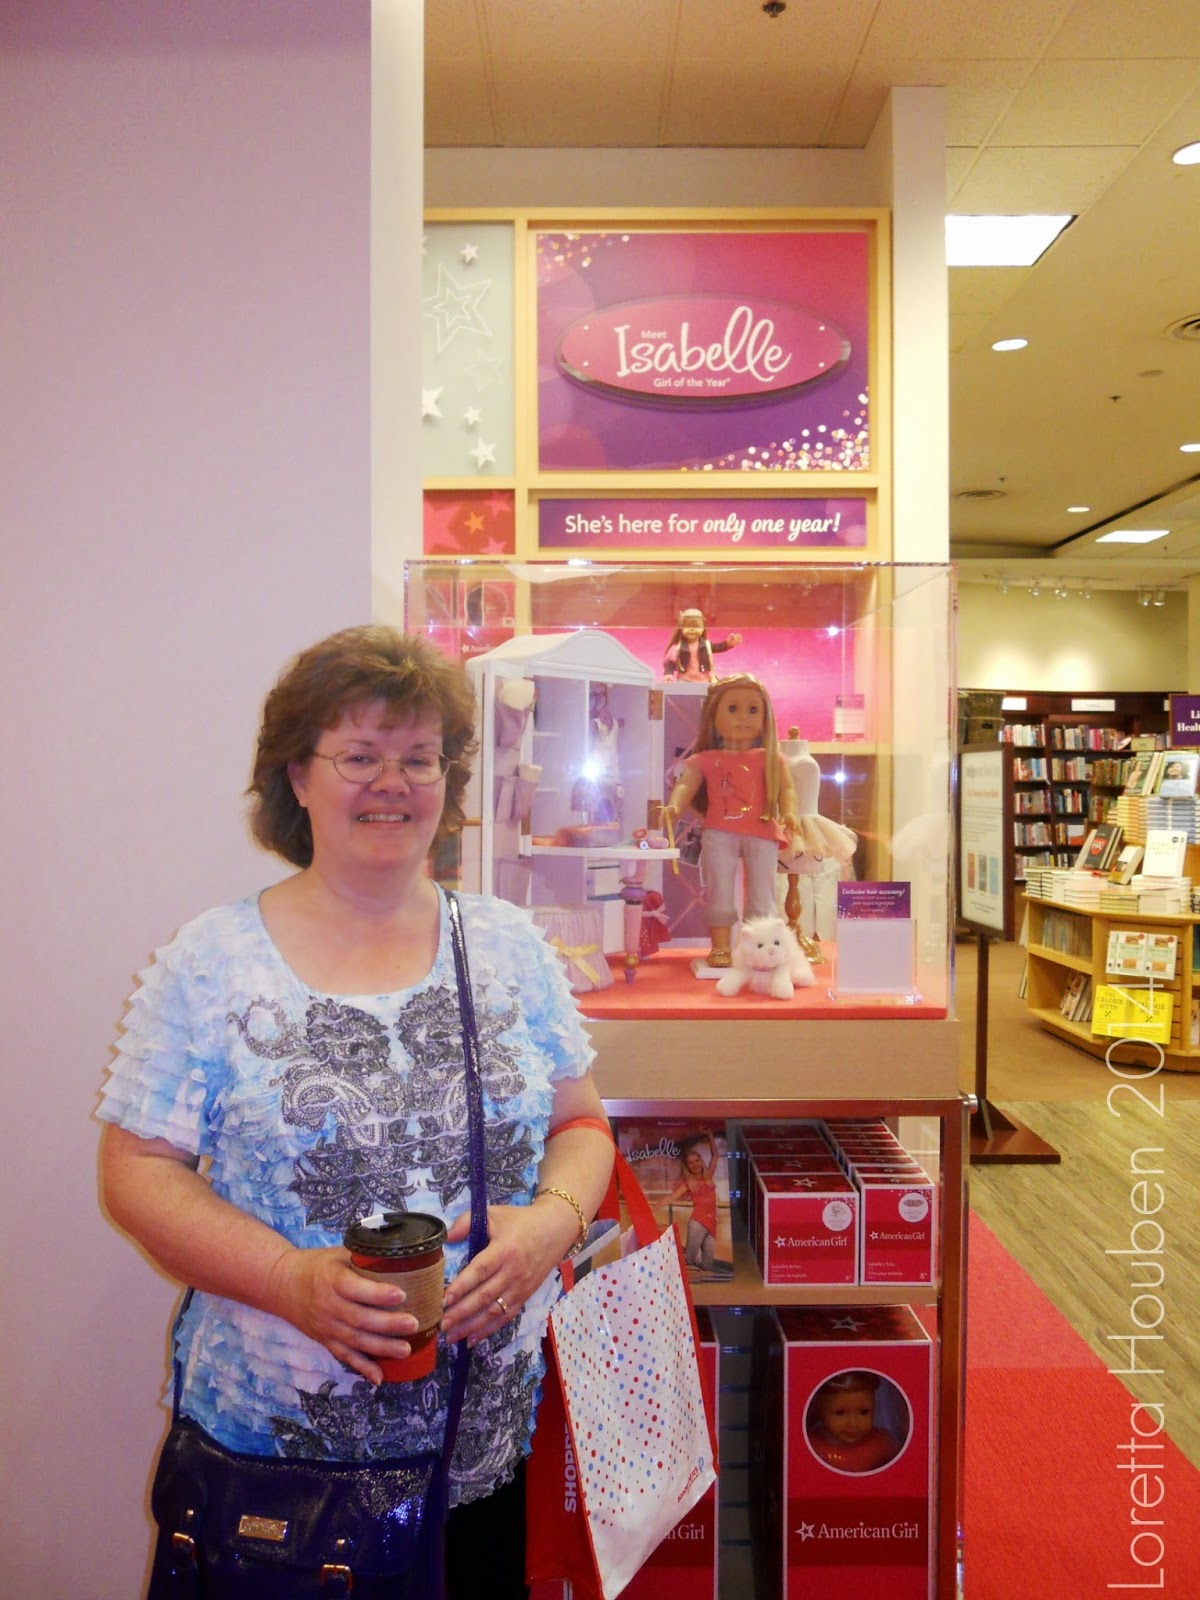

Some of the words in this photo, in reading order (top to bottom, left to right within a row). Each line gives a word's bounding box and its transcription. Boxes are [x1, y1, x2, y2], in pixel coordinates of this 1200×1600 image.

[613, 305, 793, 382] Isabelle
[641, 330, 667, 339] Meet
[653, 377, 672, 387] Girl
[673, 377, 686, 387] of
[687, 377, 704, 387] the
[564, 513, 613, 533] She's
[618, 513, 662, 533] here
[668, 513, 698, 533] for
[702, 512, 746, 541] only
[751, 518, 784, 533] one
[789, 512, 841, 541] year!
[626, 1137, 680, 1162] Isabelle
